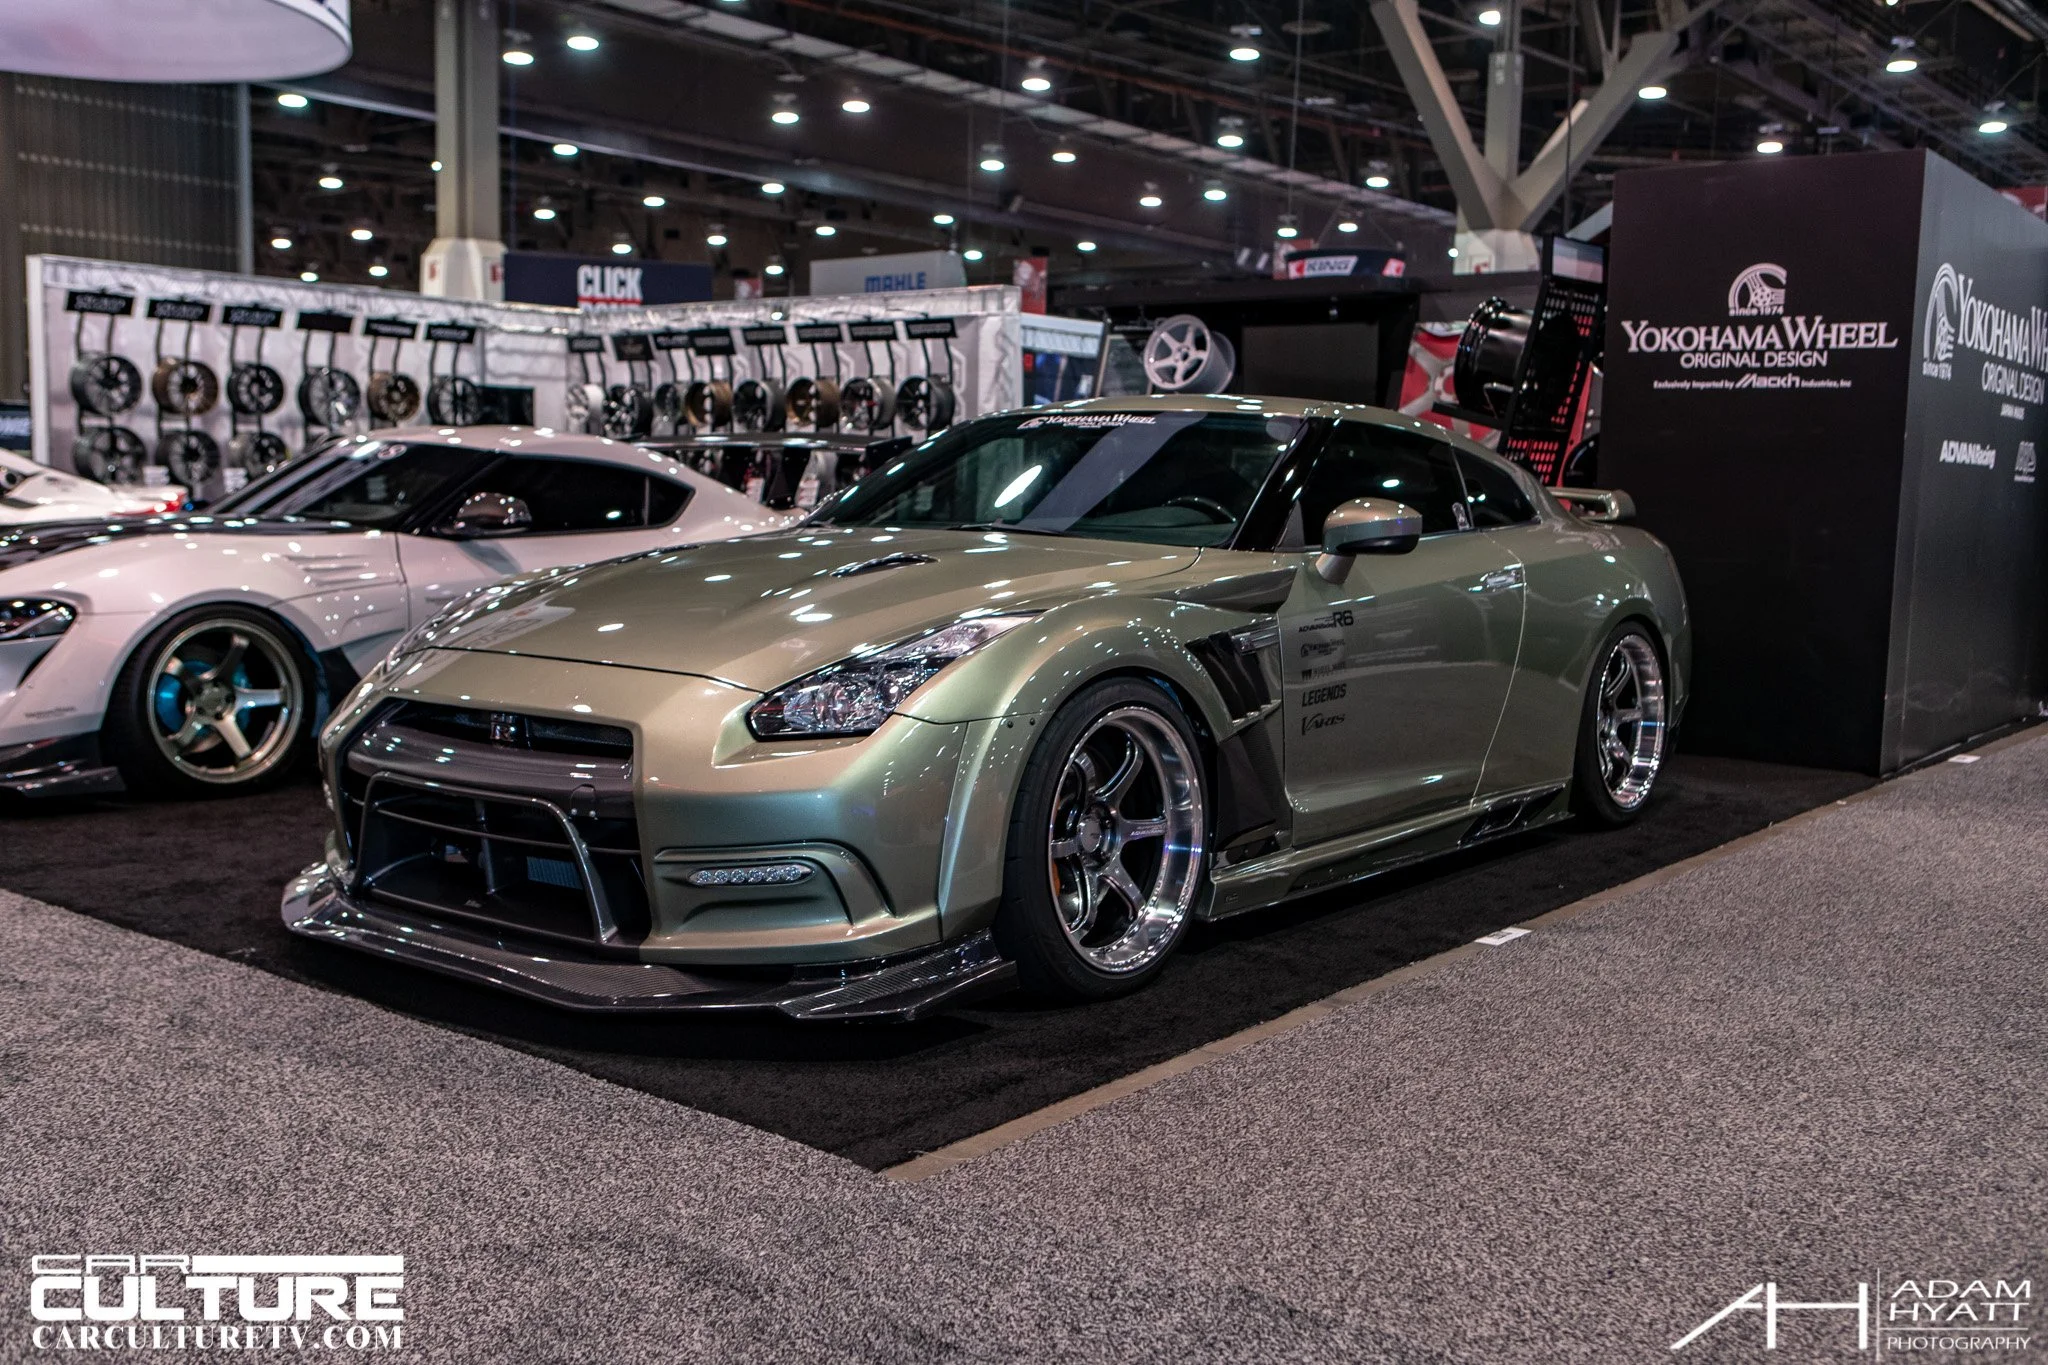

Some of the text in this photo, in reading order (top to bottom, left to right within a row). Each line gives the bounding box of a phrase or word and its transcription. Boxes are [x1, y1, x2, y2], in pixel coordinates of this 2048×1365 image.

[577, 264, 643, 301] CLICK
[864, 272, 925, 292] MAHLE
[1759, 306, 1784, 316] 1974
[1958, 273, 2030, 366] YOKOHAMA
[1621, 315, 1898, 352] YOKOHAMA WHEEL
[1680, 351, 1828, 369] ORIGINAL DESIGN
[1724, 379, 1735, 390] by
[1982, 360, 2045, 405] ORIGINAL DESIGN
[1302, 684, 1347, 708] LEGENDS
